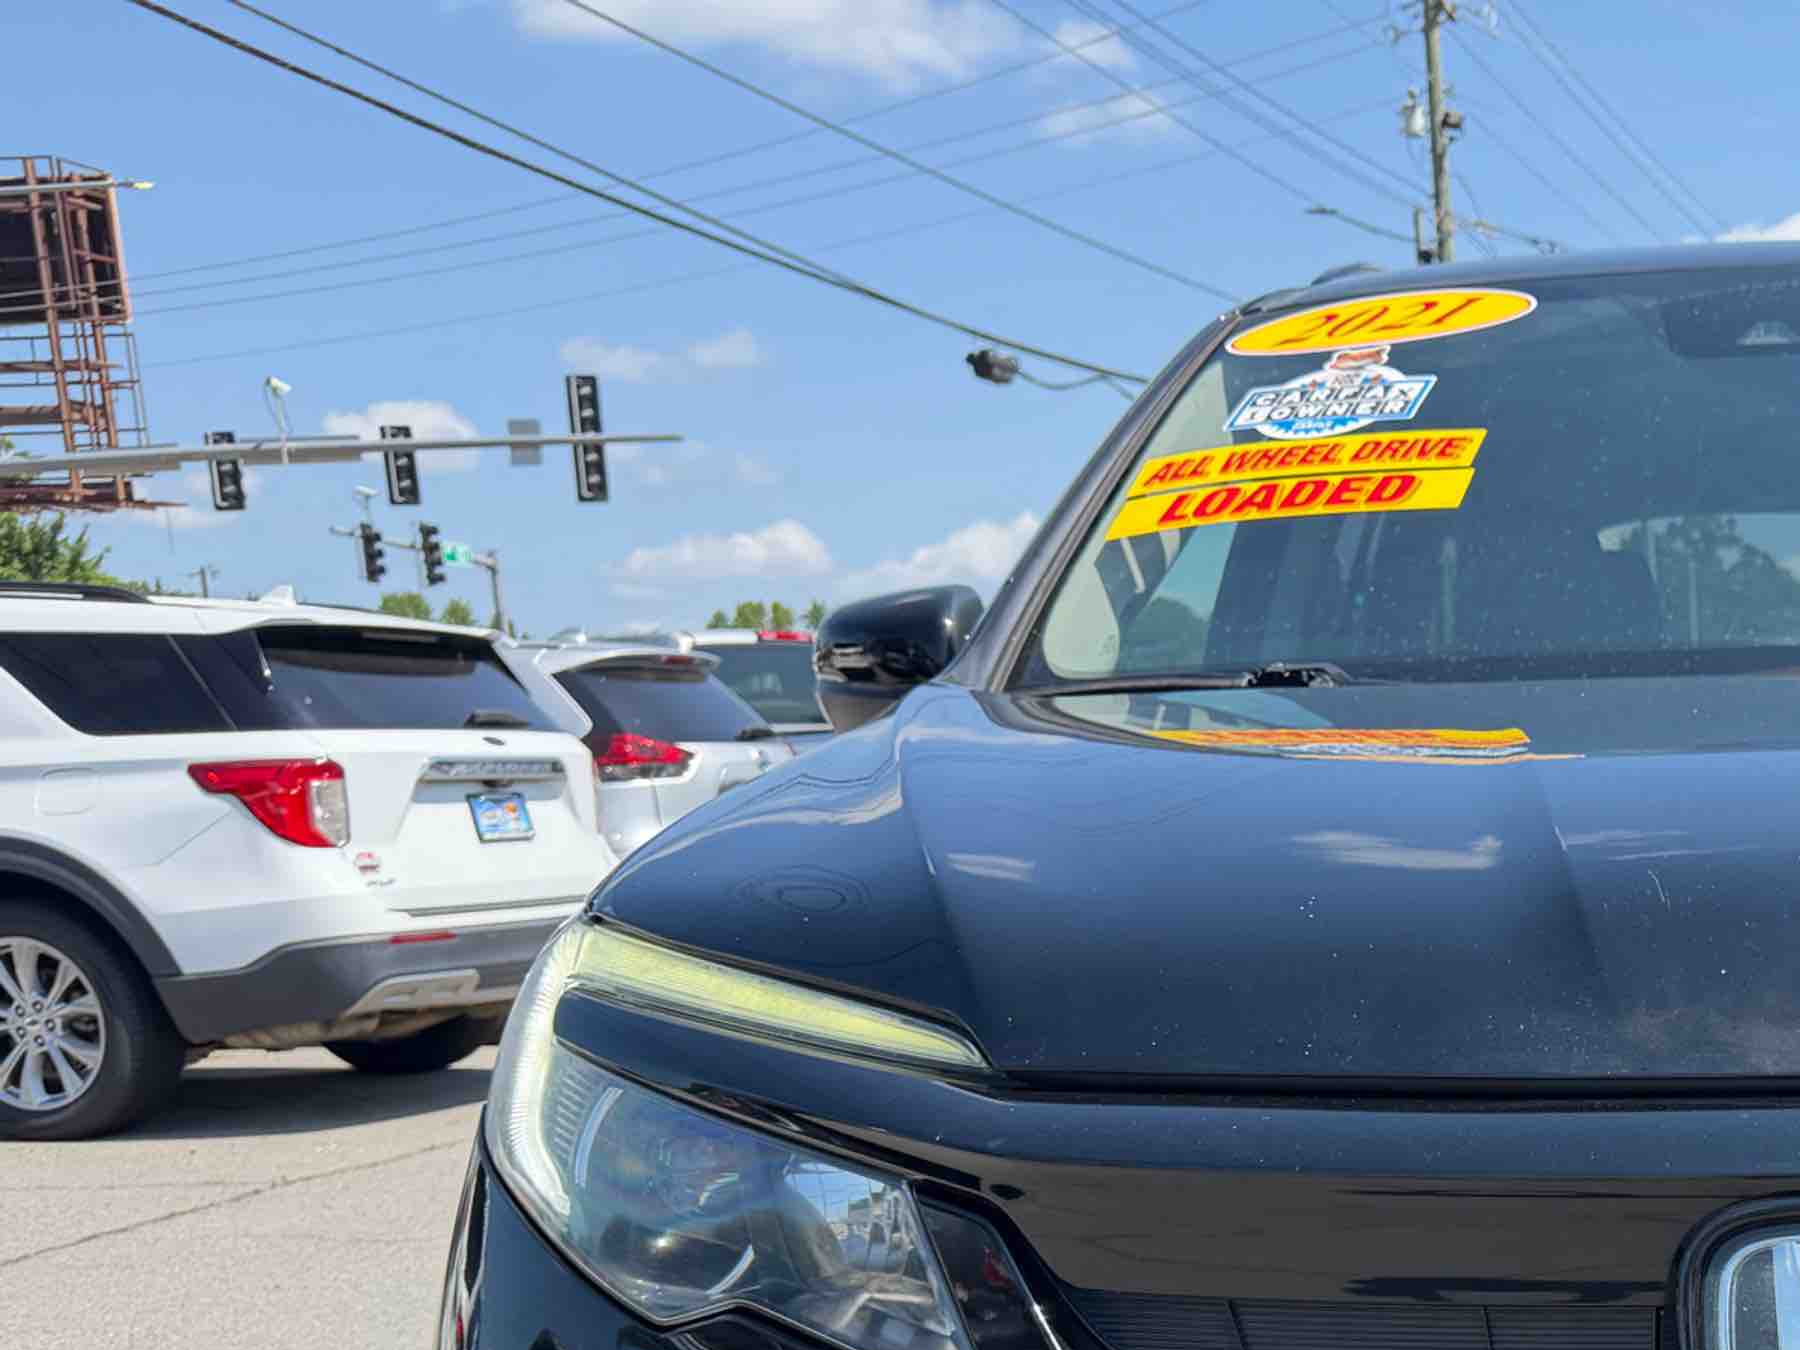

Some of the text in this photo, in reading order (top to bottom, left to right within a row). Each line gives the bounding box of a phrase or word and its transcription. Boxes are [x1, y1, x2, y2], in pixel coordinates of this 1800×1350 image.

[1272, 297, 1484, 347] 2021
[1144, 436, 1473, 487] ALL WHEEL DRIVE
[1157, 474, 1424, 526] LOADED
